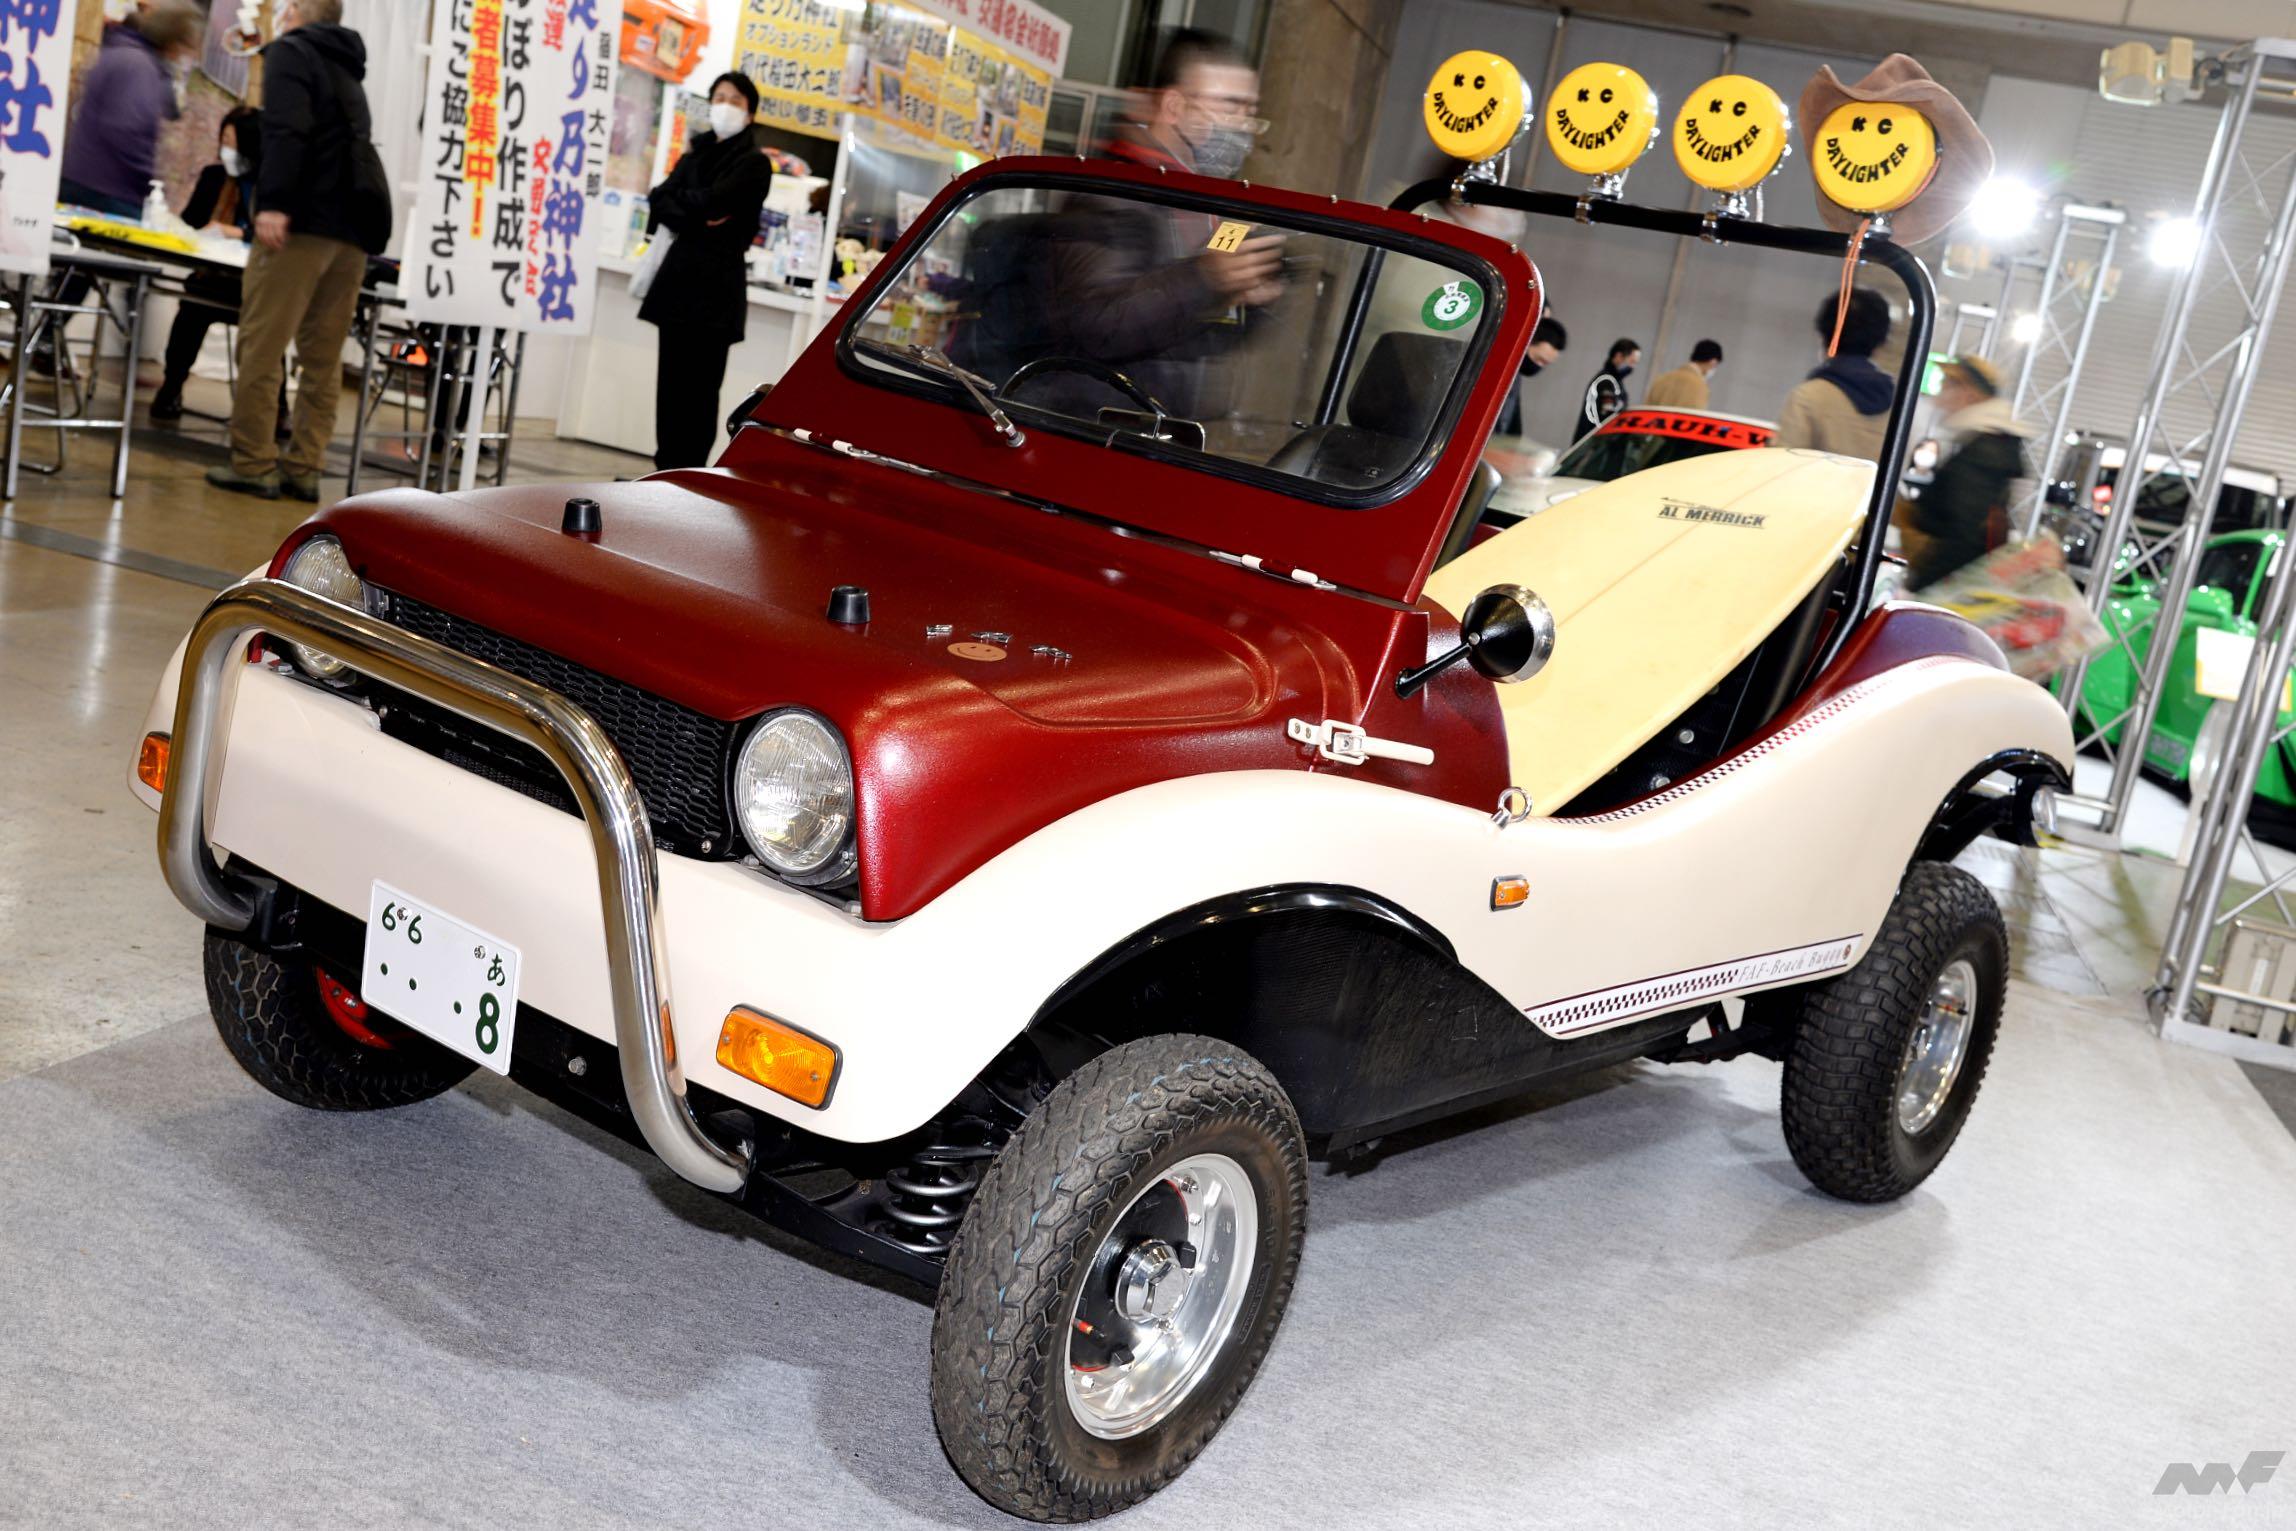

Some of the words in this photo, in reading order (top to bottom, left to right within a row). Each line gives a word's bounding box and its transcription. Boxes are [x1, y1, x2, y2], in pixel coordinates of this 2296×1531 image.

[466, 0, 501, 238] 者募集中!
[1434, 92, 1498, 133] DAYLIGHTER
[1557, 108, 1630, 149] DAYLIGHTER
[492, 0, 533, 308] ぼり作成で
[1686, 118, 1761, 162] DAYLIGHTER
[1827, 137, 1909, 183] DAYLIGHTER
[1443, 300, 1459, 314] 3
[1658, 506, 1679, 518] AL
[1685, 508, 1767, 527] MERRICK
[381, 901, 423, 945] 66
[487, 953, 506, 987] あ
